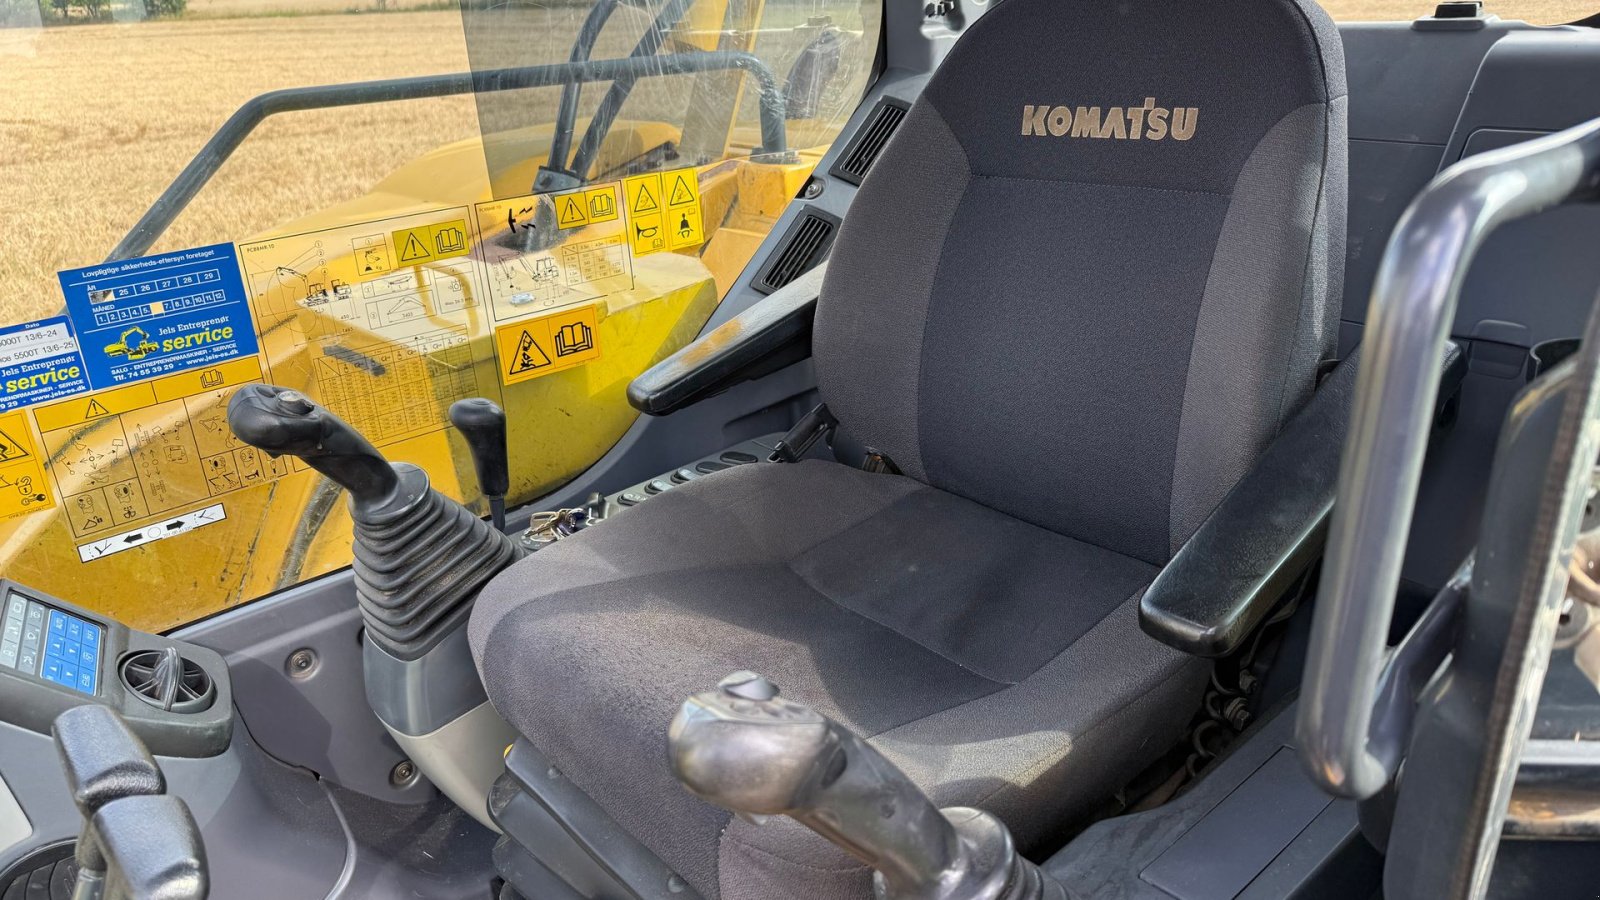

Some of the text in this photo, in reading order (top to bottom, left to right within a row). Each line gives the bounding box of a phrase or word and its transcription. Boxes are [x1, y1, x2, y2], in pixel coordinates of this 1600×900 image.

[1021, 97, 1199, 141] KOMATSU
[82, 249, 215, 278] Lovpligtige sikkerheds-eftersyn foretaget
[119, 272, 214, 296] 25 26 27 28 29
[92, 304, 115, 313] MÅNED
[25, 329, 57, 341] 13/6-24
[158, 315, 229, 336] Jels Entreprenør
[13, 348, 38, 360] 5500T
[42, 341, 74, 353] 13/6-25
[162, 326, 233, 353] service
[1, 355, 75, 377] Jels Entreprenør
[111, 367, 129, 375] SALG
[212, 343, 237, 352] SERVICE
[163, 363, 174, 371] 29
[6, 366, 80, 393] service
[58, 379, 84, 389] SERVICE
